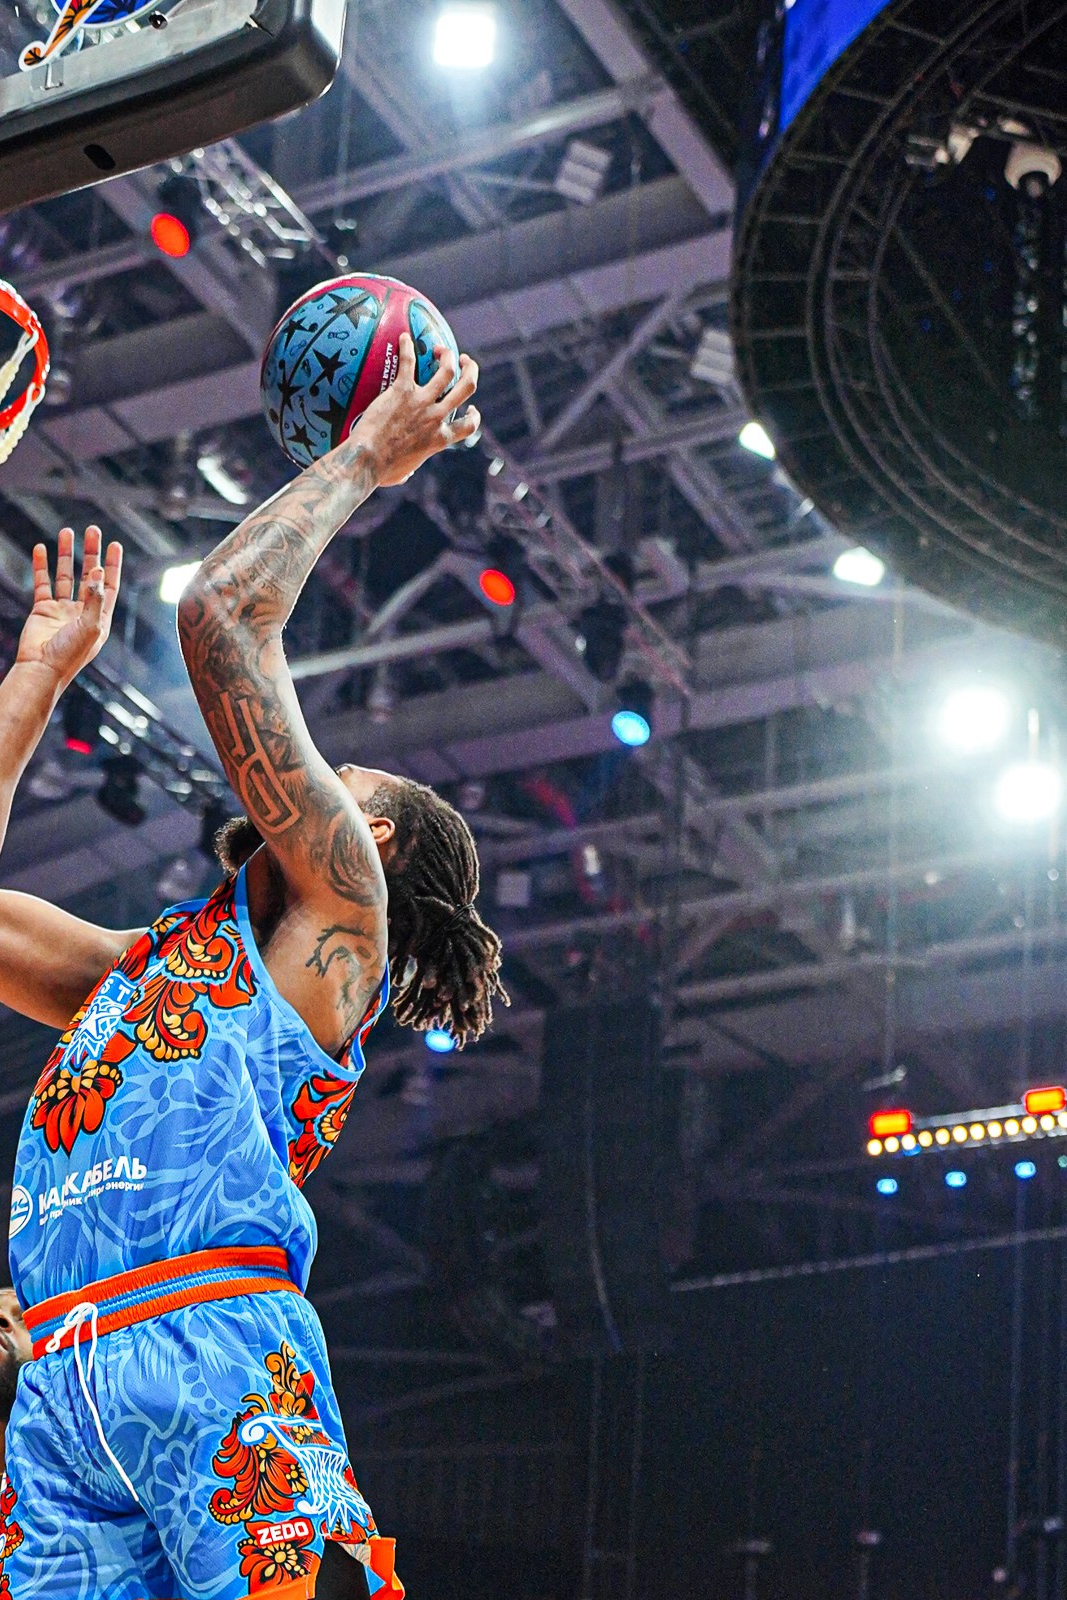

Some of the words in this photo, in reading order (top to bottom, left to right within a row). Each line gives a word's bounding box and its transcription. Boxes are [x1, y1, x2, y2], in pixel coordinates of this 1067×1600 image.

[382, 342, 393, 379] ALL-STAR
[38, 1155, 148, 1216] КАКАБЕЛЬ
[256, 1521, 310, 1546] ZEDO
